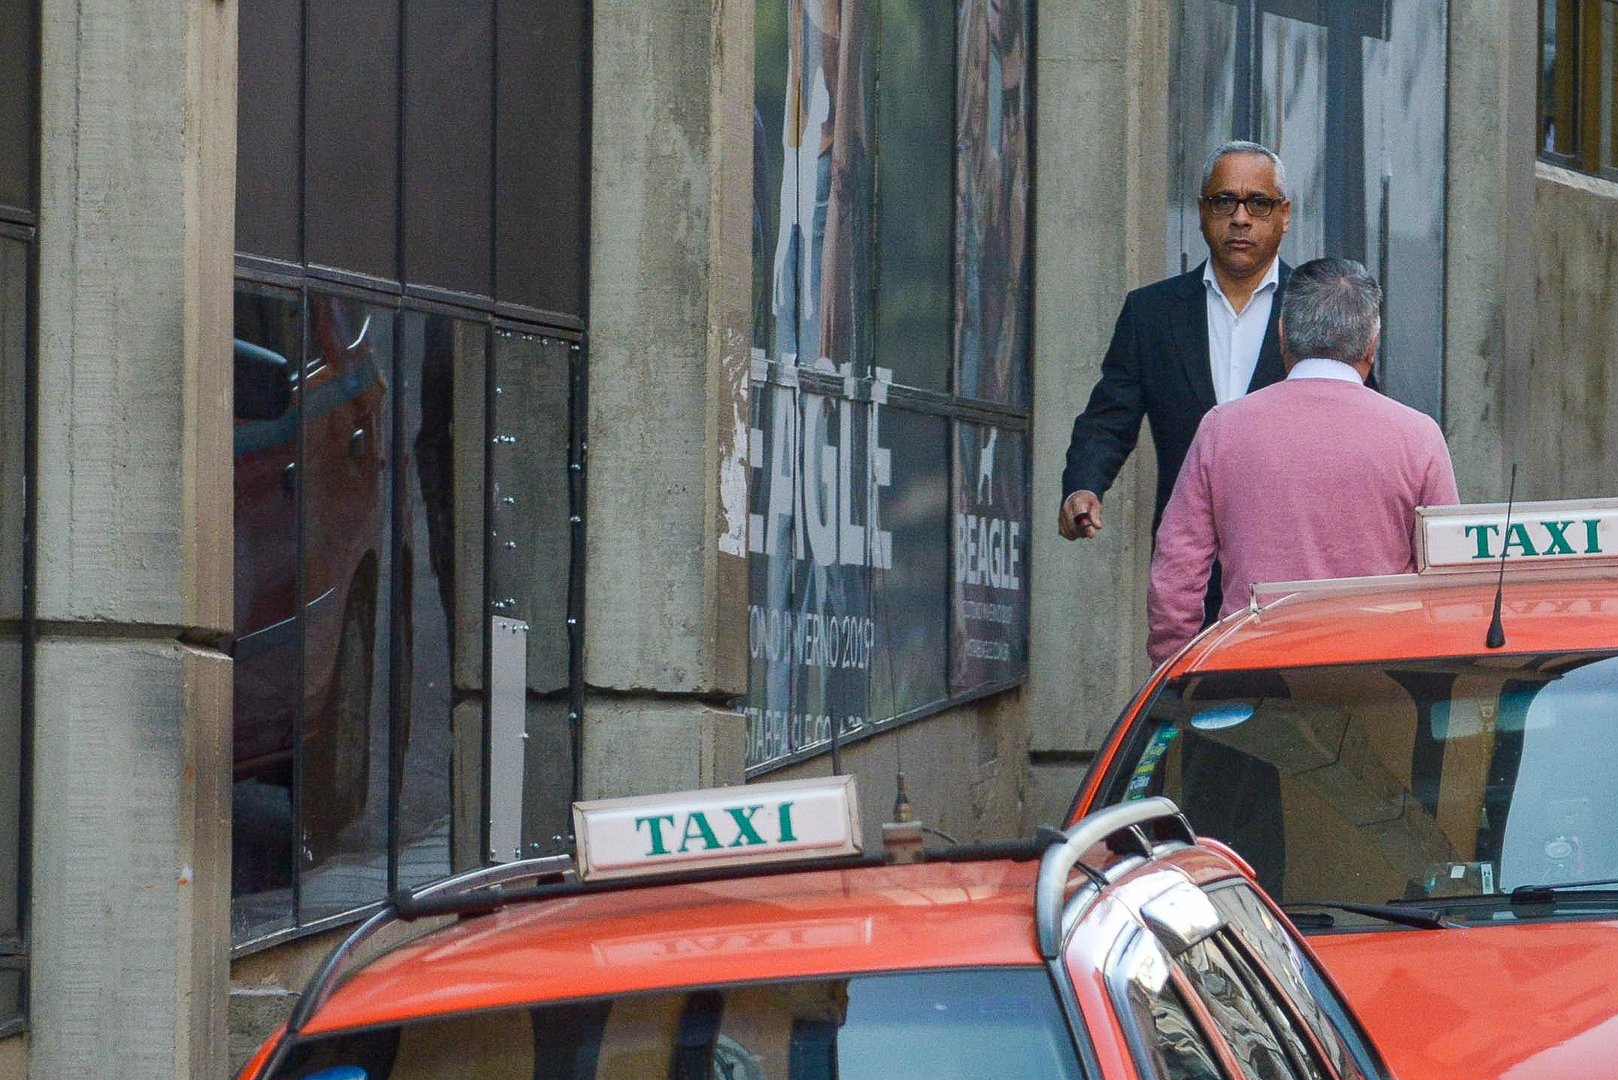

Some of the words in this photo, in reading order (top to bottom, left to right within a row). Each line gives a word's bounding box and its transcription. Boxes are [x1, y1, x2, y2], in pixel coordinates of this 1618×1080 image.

[955, 513, 1019, 590] BEAGLE
[1465, 518, 1602, 559] TAXI
[842, 615, 875, 671] 2019
[635, 802, 798, 856] TAXI
